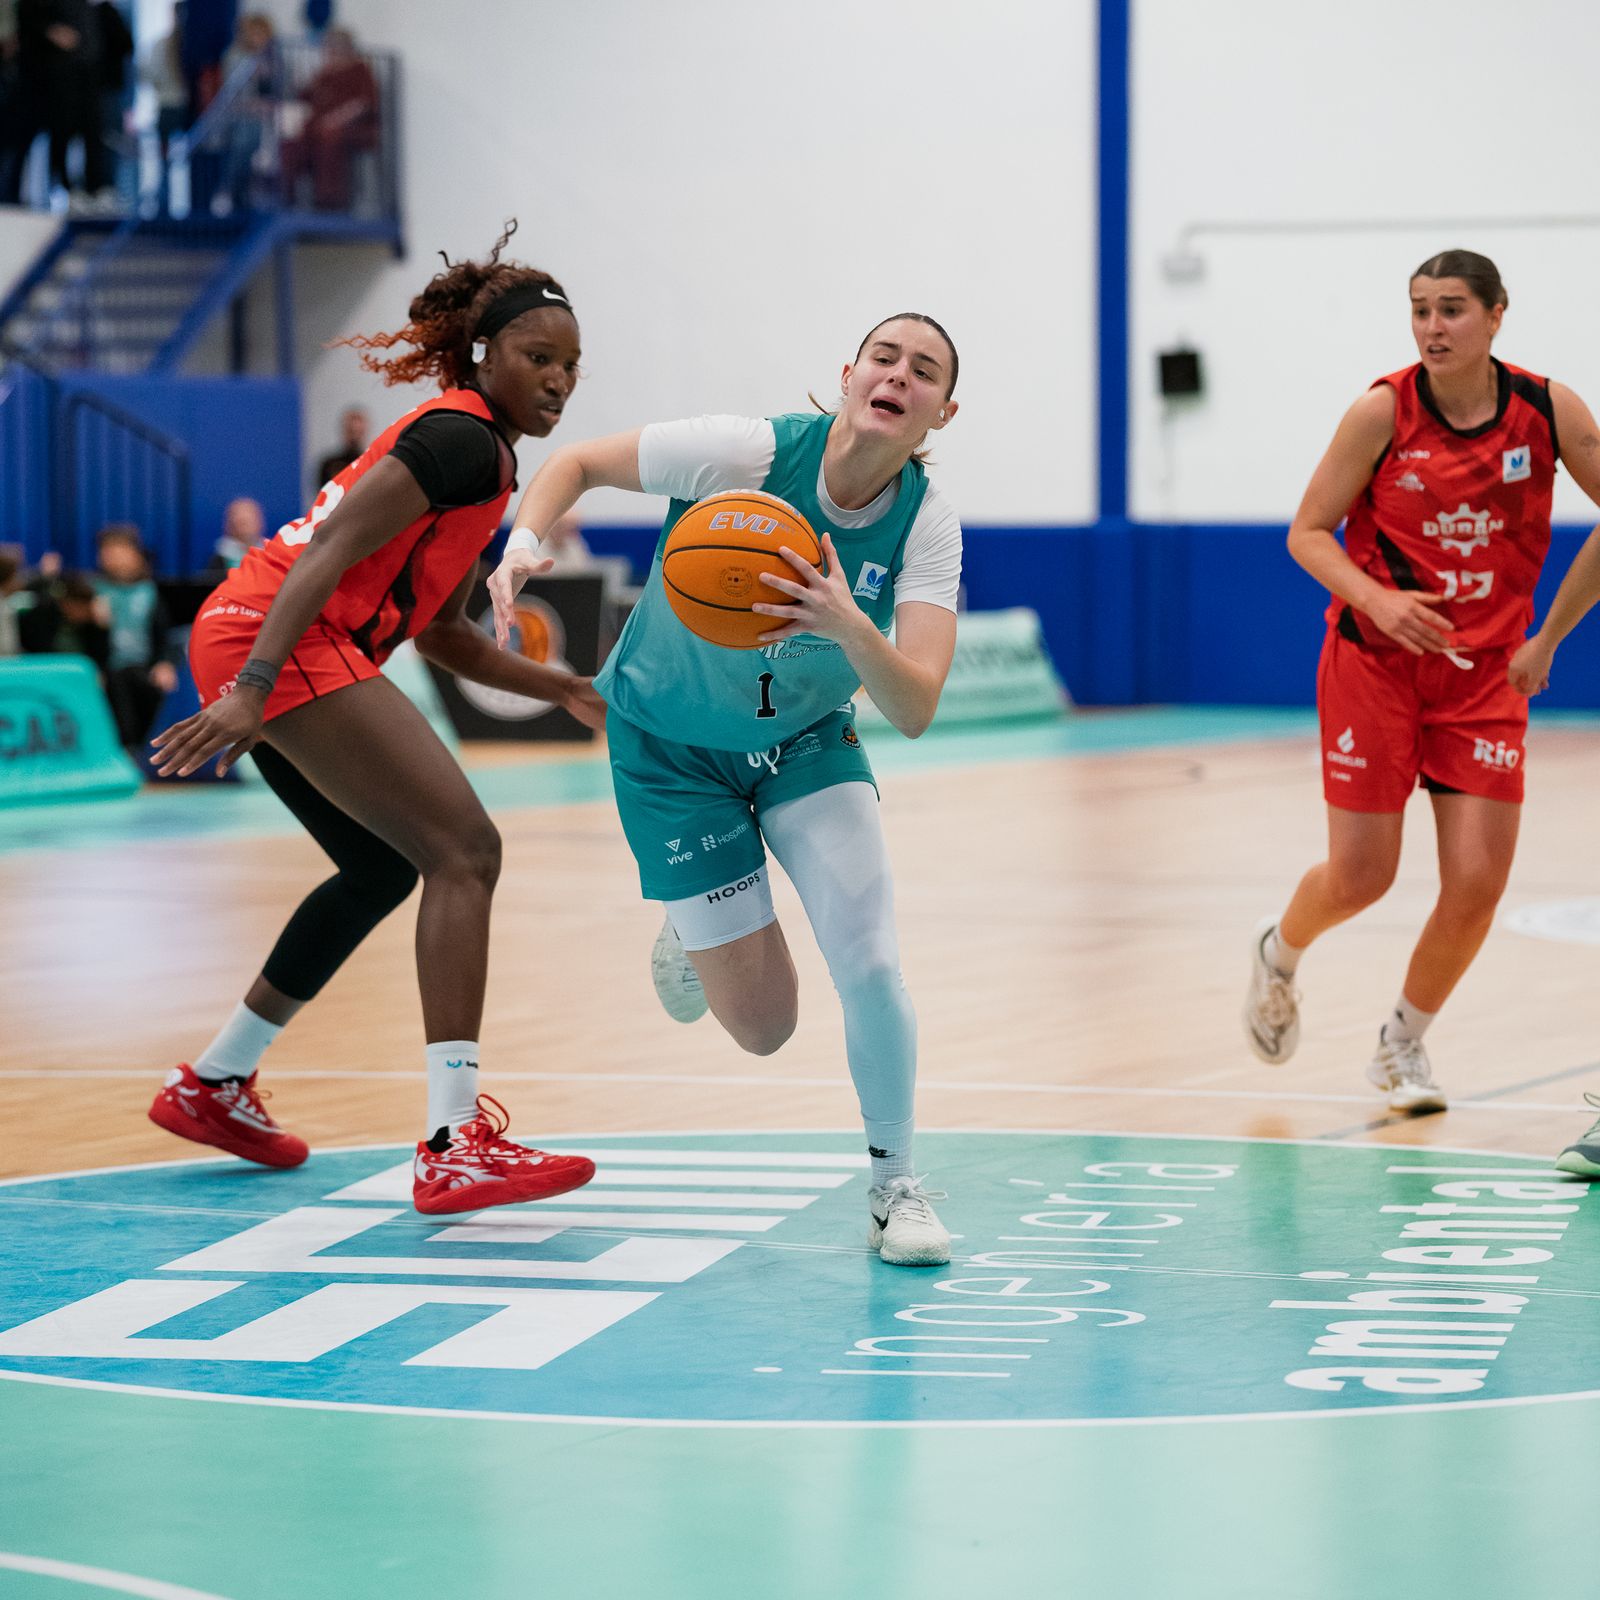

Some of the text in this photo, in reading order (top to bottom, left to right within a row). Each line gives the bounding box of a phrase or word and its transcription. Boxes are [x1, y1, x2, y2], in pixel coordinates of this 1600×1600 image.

[709, 511, 778, 535] EVO
[227, 605, 239, 614] de
[755, 671, 778, 719] 1
[666, 851, 694, 865] vive
[706, 872, 760, 904] HOOPS
[753, 1161, 1240, 1378] ingeniería
[1268, 1165, 1592, 1395] ambiental
